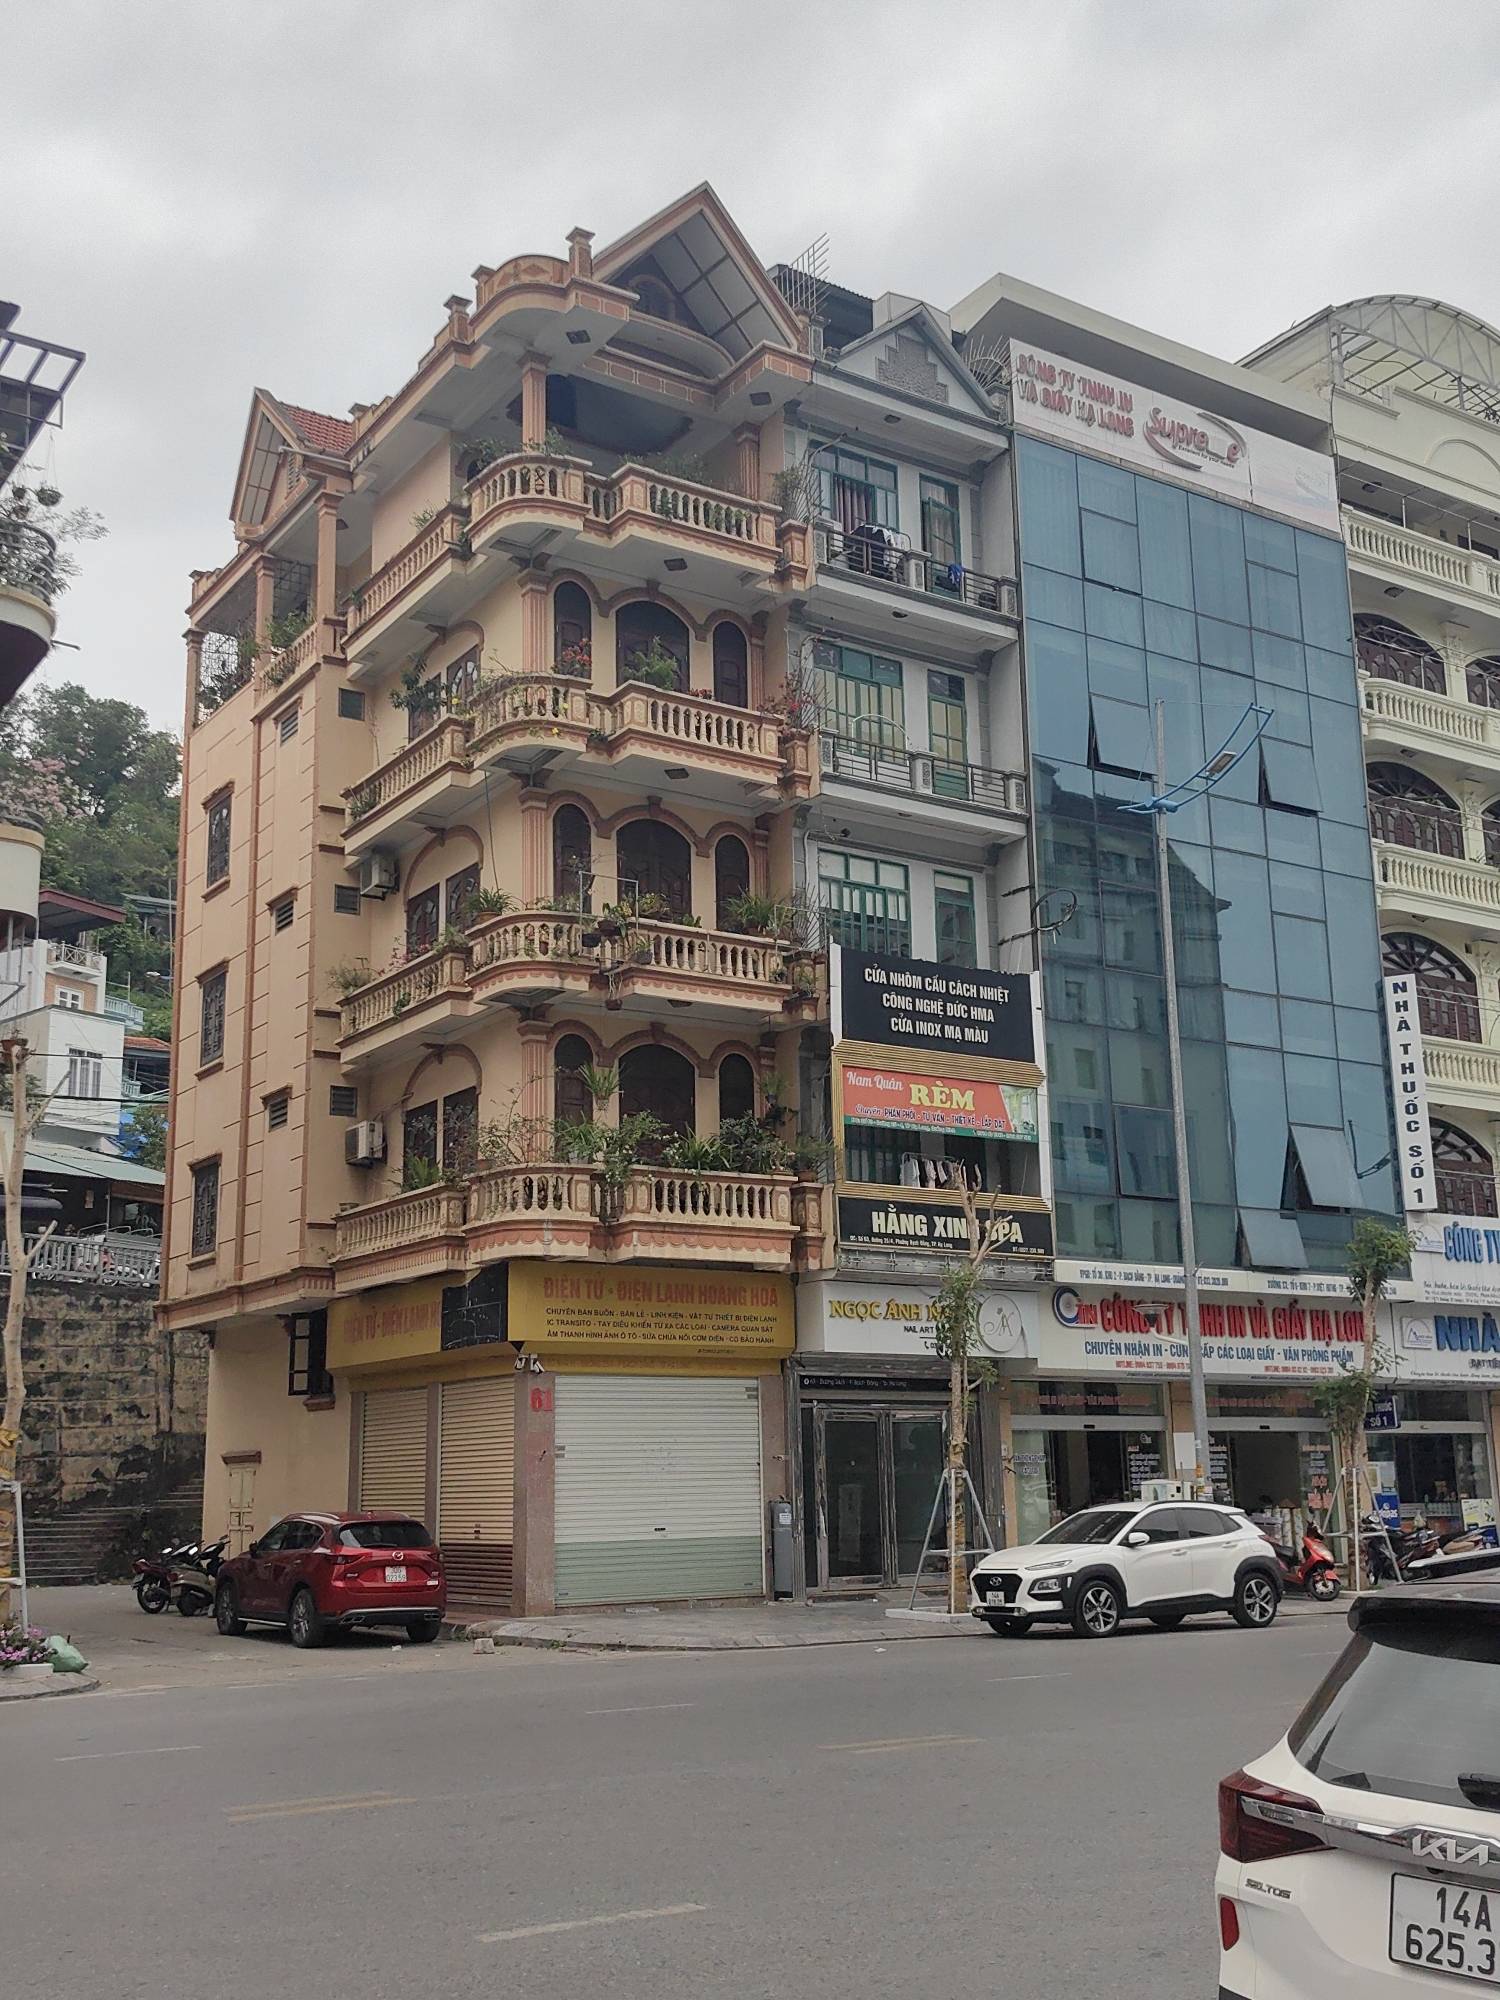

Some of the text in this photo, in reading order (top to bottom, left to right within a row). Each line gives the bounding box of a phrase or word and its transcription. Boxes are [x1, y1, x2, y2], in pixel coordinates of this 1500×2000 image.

[1057, 369, 1073, 392] TY
[1075, 376, 1113, 406] TNHH
[1115, 391, 1131, 413] IN
[1095, 408, 1132, 437] LONG
[1149, 407, 1240, 463] Supree
[864, 964, 887, 985] CỬA
[890, 971, 922, 990] NHÔM
[949, 981, 977, 998] CÁCH
[980, 986, 1009, 1005] NHIỆT
[882, 992, 994, 1022] CÔNG NGHỆ ĐỨC HMA
[890, 1013, 989, 1044] CỬA INOX MẠ MÀU
[846, 1072, 904, 1091] Nam Quân
[909, 1080, 975, 1111] RÈM
[1392, 981, 1425, 1204] NHÀ THUỐC SỐ 1
[871, 1204, 928, 1236] HẰNG
[1444, 1221, 1484, 1263] CÔNG
[543, 1276, 580, 1302] ĐIỆN
[617, 1278, 652, 1306] ĐIỆN
[656, 1282, 695, 1308] LẠNH
[546, 1307, 576, 1315] CHUYÊN
[594, 1308, 614, 1317] BUÔN
[829, 1300, 882, 1322] NGỌC
[884, 1298, 922, 1321] ÁNH
[1226, 1304, 1247, 1338] IN
[1248, 1299, 1270, 1339] VÀ
[1272, 1298, 1307, 1341] GIẤY
[1310, 1310, 1334, 1347] HẠ
[1334, 1310, 1376, 1342] LON
[904, 1325, 934, 1334] NAIL ART
[1084, 1340, 1122, 1355] CHUYÊN
[1124, 1341, 1150, 1358] NHẬN
[1153, 1344, 1163, 1356] IN
[1170, 1344, 1189, 1358] CUN
[1217, 1344, 1234, 1359] CÁC
[1236, 1348, 1255, 1362] LOẠI
[1257, 1344, 1275, 1360] GIẤY
[1283, 1346, 1299, 1361] VĂN
[1302, 1346, 1329, 1362] PHÒNG
[530, 1388, 552, 1412] 61
[1370, 1414, 1387, 1426] SỐ 1
[1244, 1878, 1292, 1899] SELTOS
[1436, 1886, 1492, 1932] 14A
[1406, 1924, 1500, 1976] 625.3
